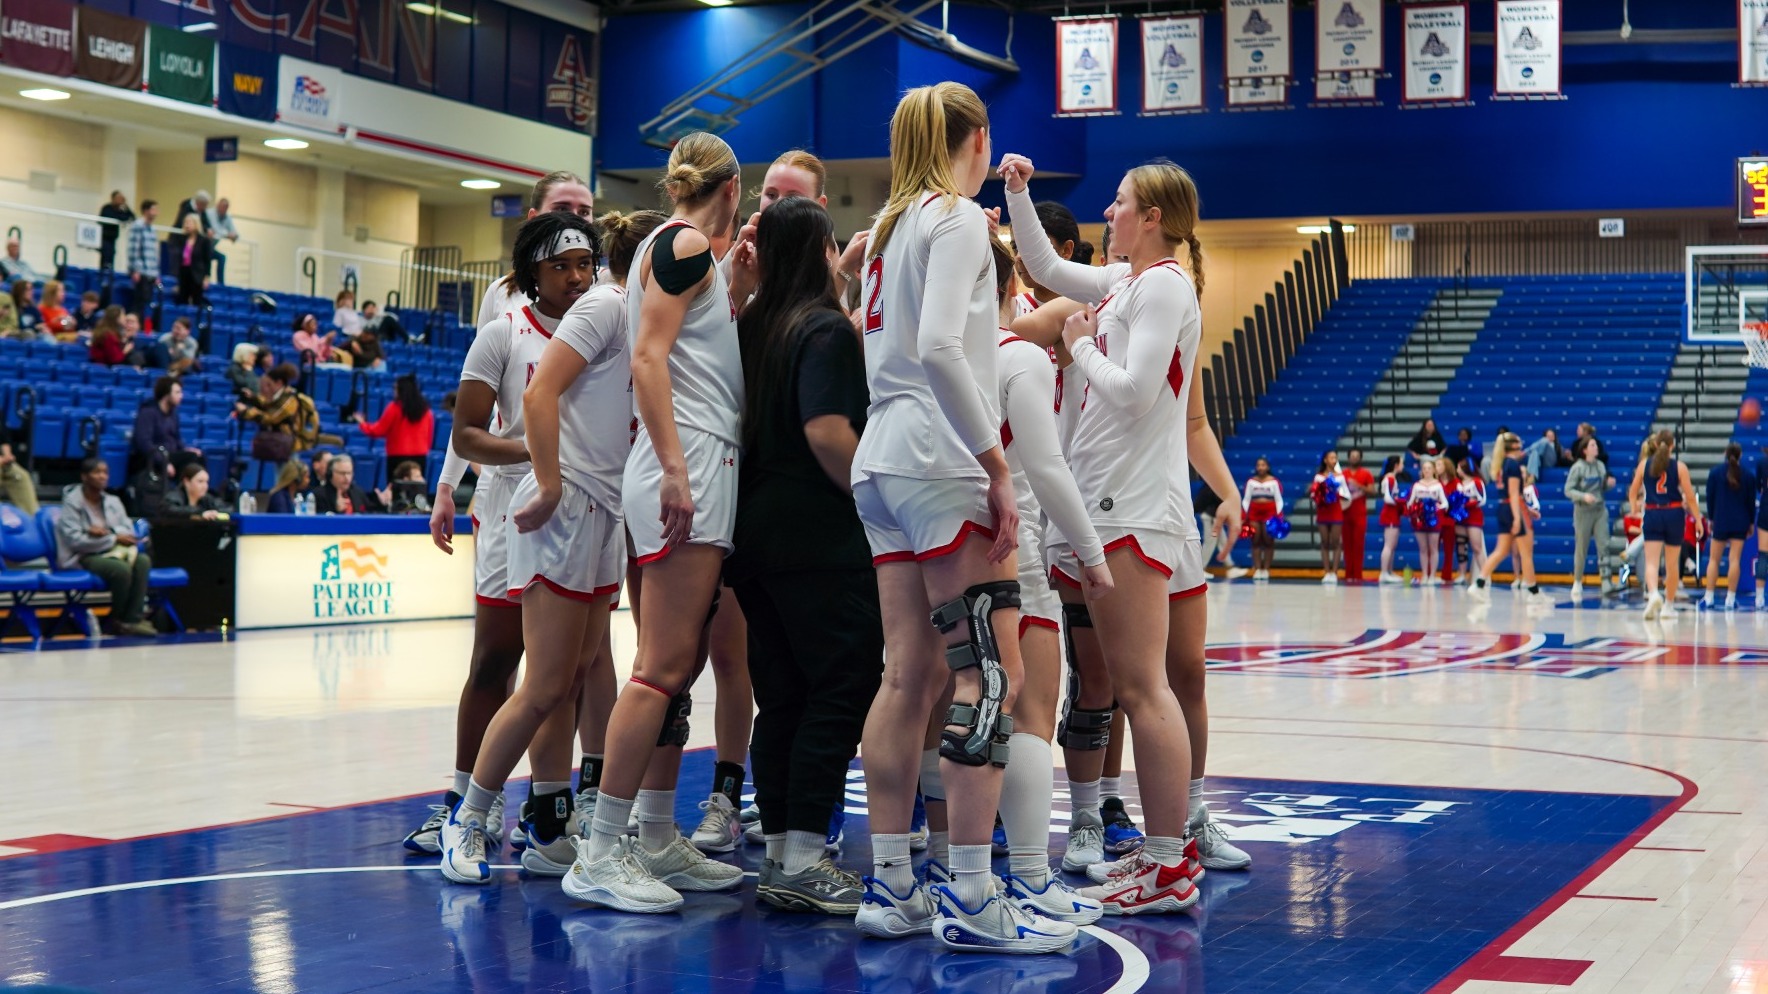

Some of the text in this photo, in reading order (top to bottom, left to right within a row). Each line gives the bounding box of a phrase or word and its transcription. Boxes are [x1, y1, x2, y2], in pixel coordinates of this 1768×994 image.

[1, 16, 71, 51] LAFAYETTE
[1408, 20, 1462, 29] VOLLEYBALL
[89, 35, 136, 64] LEHIGH
[160, 51, 204, 79] LOYOLA
[233, 72, 264, 96] NAVY
[865, 253, 884, 336] 2
[1656, 470, 1668, 495] 2
[313, 581, 394, 600] PATRIOT
[314, 599, 396, 618] LEAGUE
